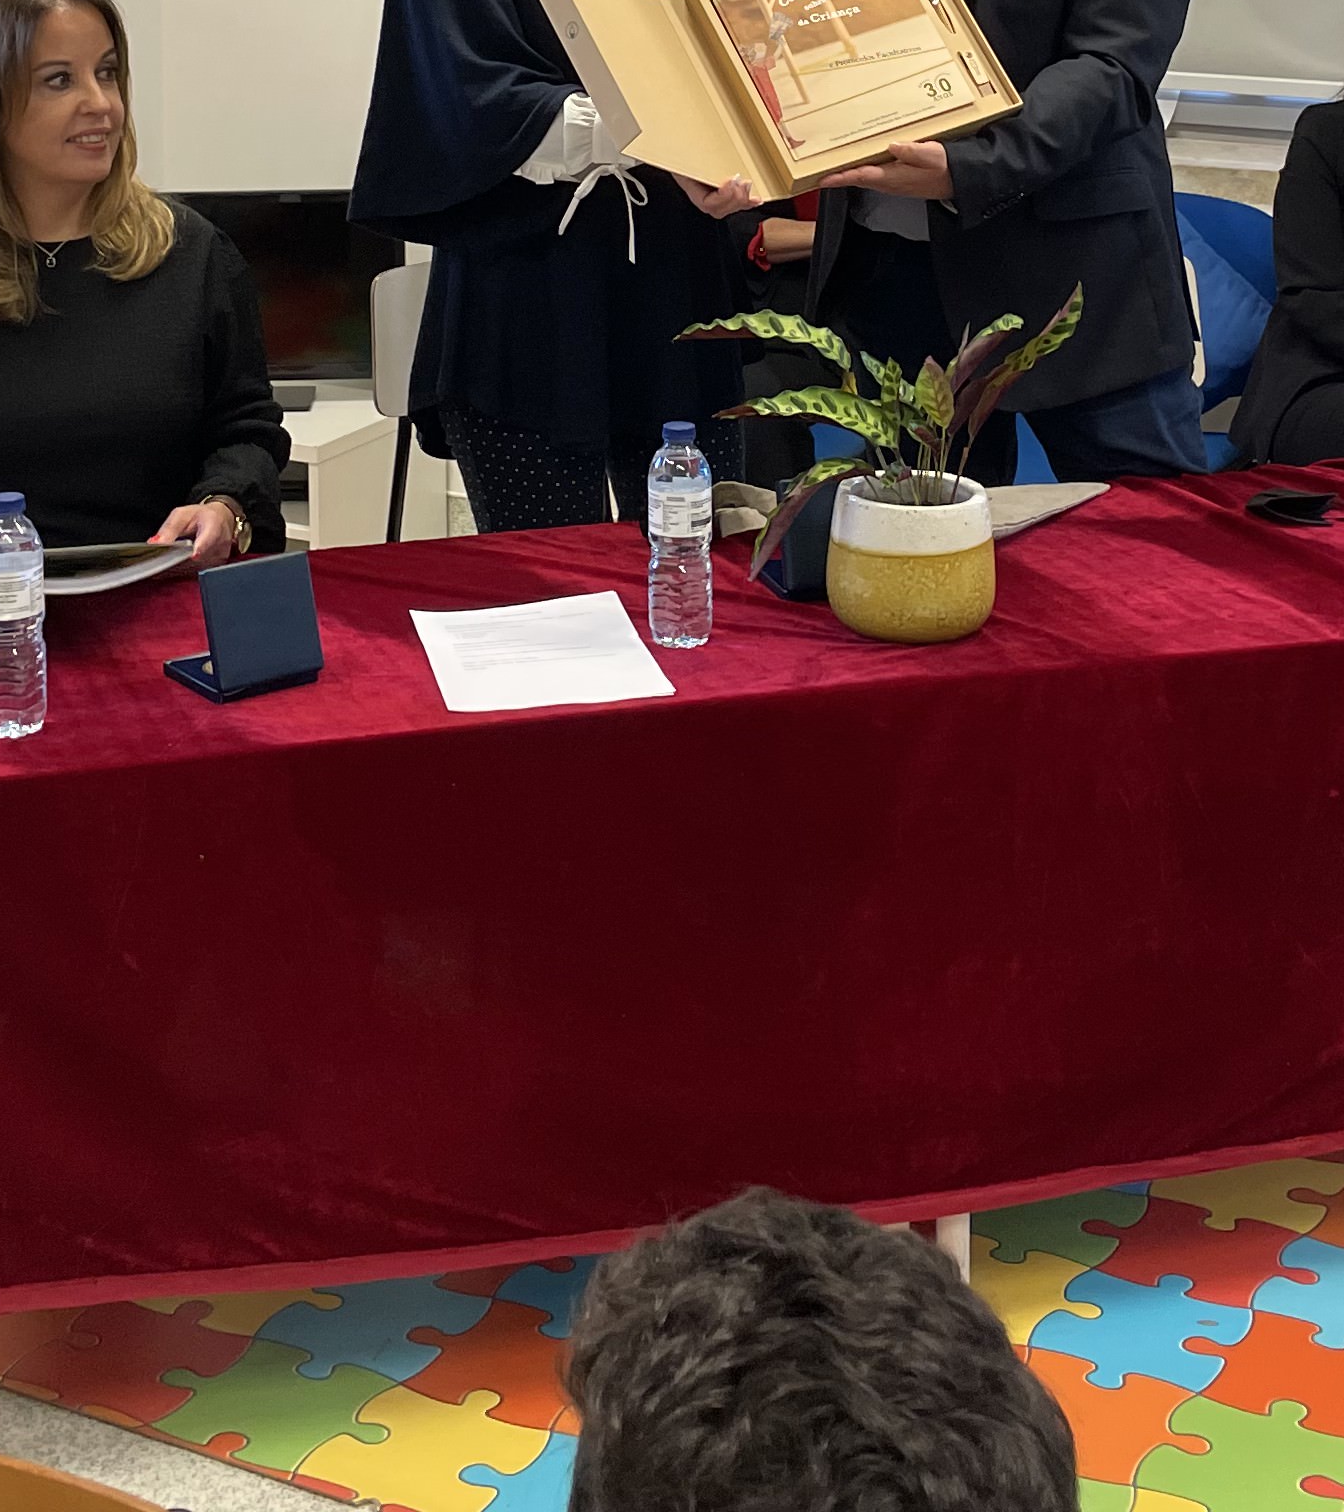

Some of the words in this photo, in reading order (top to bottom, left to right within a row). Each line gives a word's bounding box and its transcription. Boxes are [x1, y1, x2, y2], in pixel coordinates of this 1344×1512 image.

[797, 18, 810, 27] da
[809, 5, 861, 23] Criança
[923, 78, 952, 98] 30
